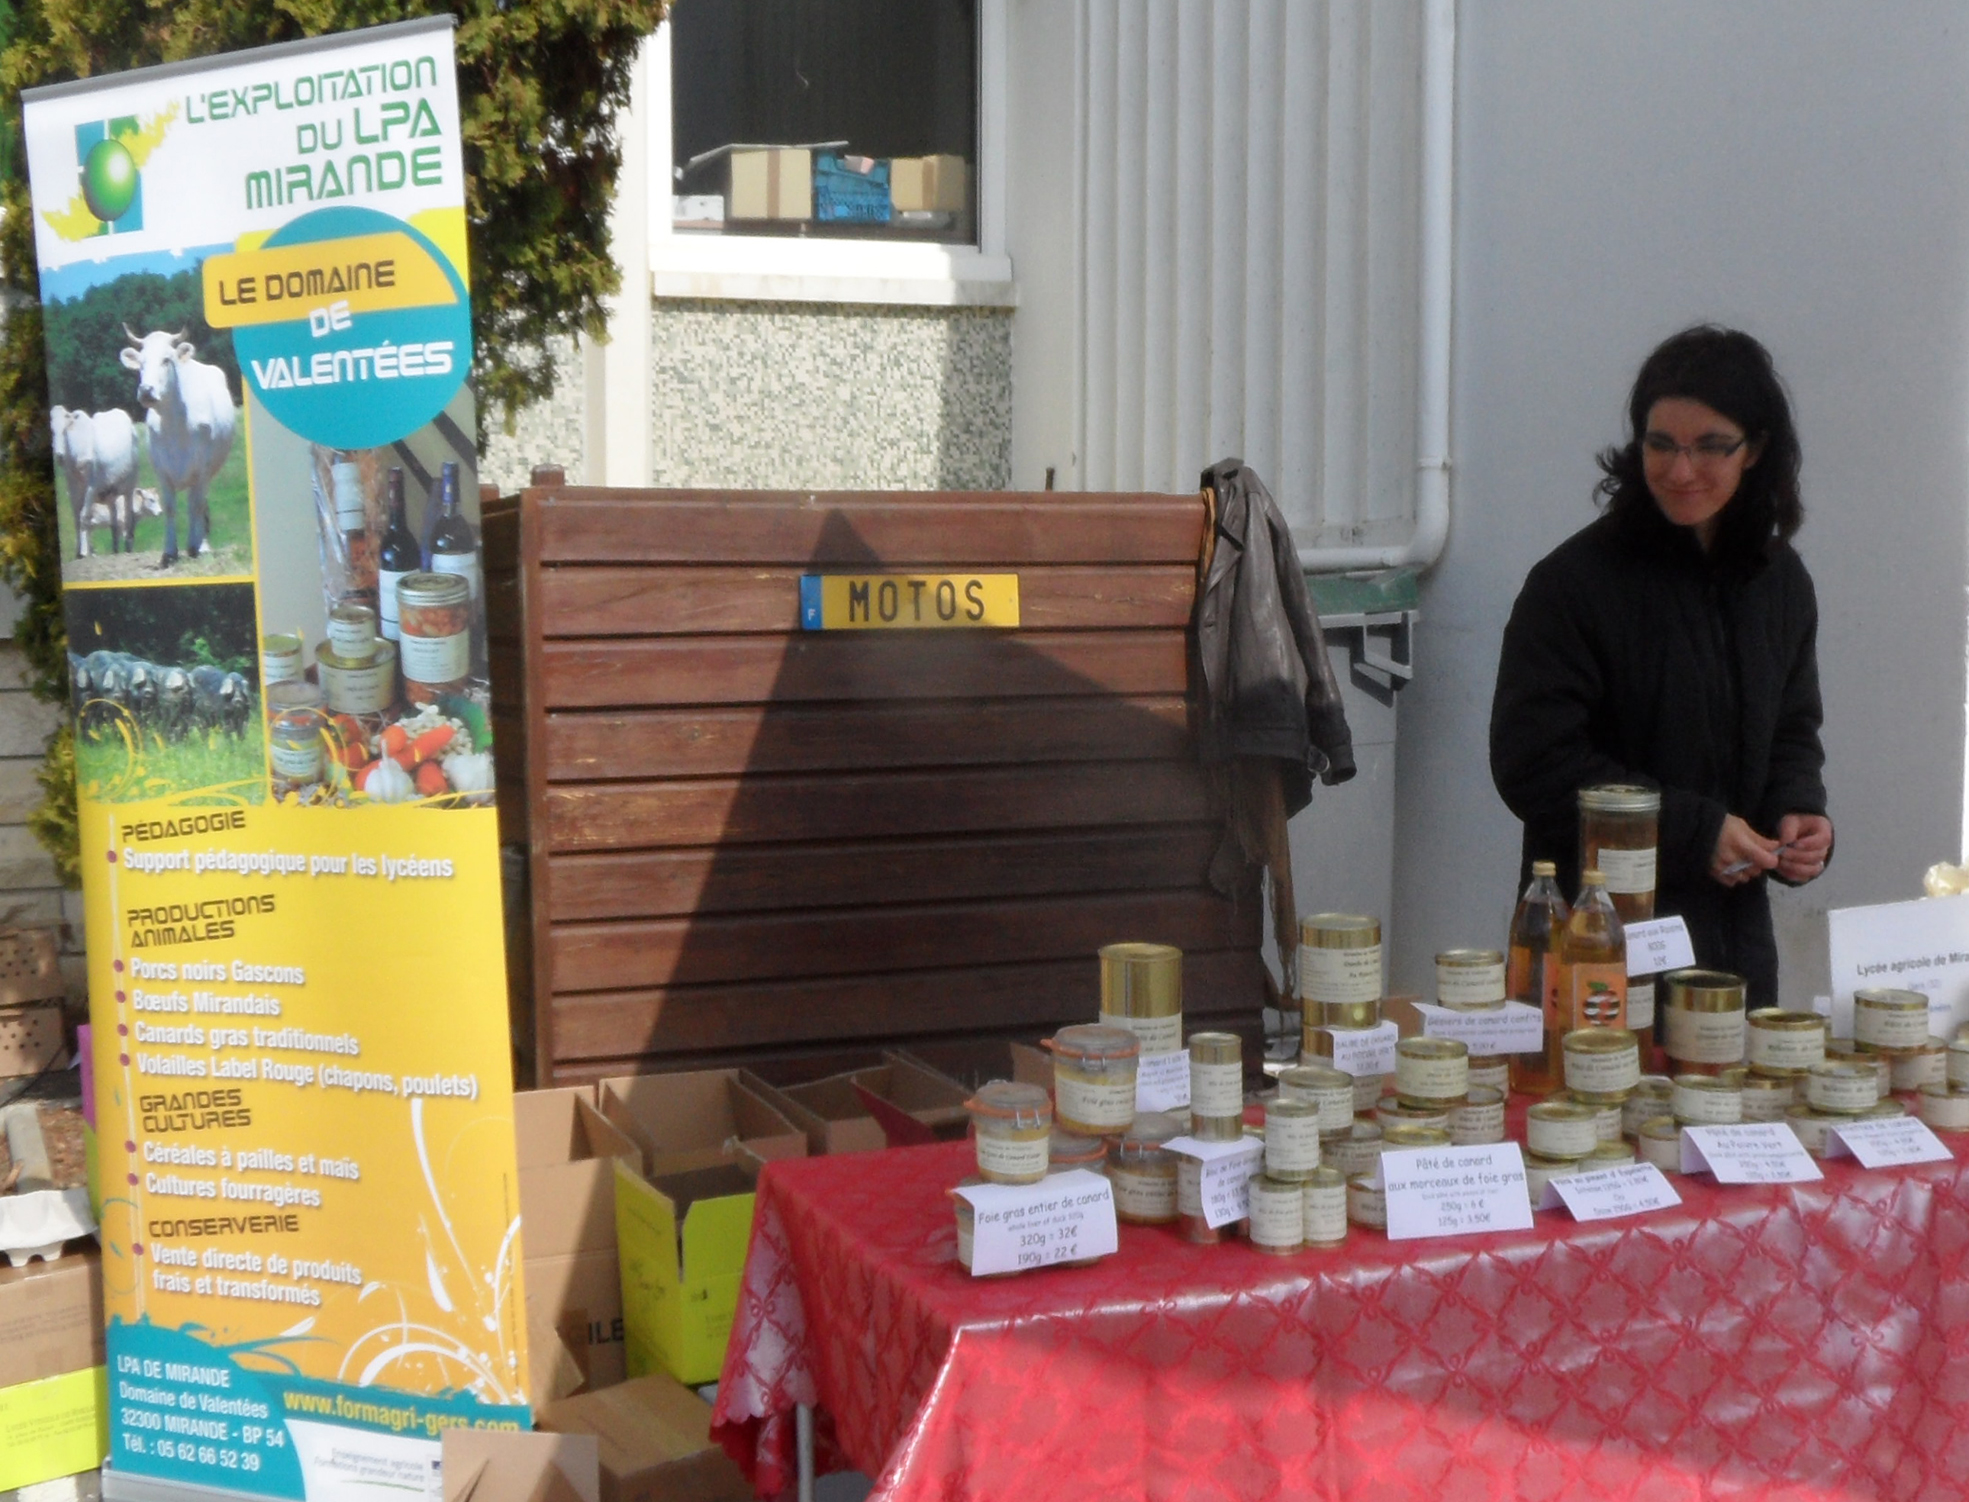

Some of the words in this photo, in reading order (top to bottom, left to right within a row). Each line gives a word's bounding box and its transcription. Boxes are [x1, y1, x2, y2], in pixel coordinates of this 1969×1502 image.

[186, 55, 437, 124] L'EXPLOITATION
[297, 118, 342, 155] DU
[354, 97, 442, 145] LPA
[245, 145, 442, 209] MIRANDE
[218, 277, 257, 306] LE
[265, 260, 395, 301] DOMAINE
[309, 300, 353, 337] DE
[251, 339, 454, 390] VALENTÉES
[849, 579, 984, 622] MOTOS
[121, 810, 246, 843] PÉDAGOGIE
[123, 847, 191, 873] Support
[194, 848, 306, 875] pédagogique
[310, 854, 347, 876] pour
[352, 853, 377, 875] les
[381, 854, 454, 881] lycéens
[126, 893, 275, 928] PRODUCTIONS
[131, 920, 235, 948] ANIMALES
[131, 957, 178, 980] Porcs
[182, 959, 227, 981] noirs
[232, 959, 305, 984] Gascons
[1857, 963, 1887, 978] Lycée
[1891, 956, 1932, 973] agricole
[1934, 954, 1946, 967] de
[133, 989, 189, 1012] Bœufs
[193, 992, 281, 1015] Mirandais
[135, 1021, 204, 1044] Canards
[210, 1027, 248, 1050] gras
[253, 1025, 360, 1055] traditionnels
[138, 1052, 206, 1077] Volailles
[211, 1056, 257, 1079] Label
[261, 1057, 315, 1086] Rouge
[319, 1063, 398, 1096] (chapons,
[402, 1073, 478, 1100] poulets)
[140, 1088, 242, 1113] GRANDES
[143, 1108, 251, 1133] CULTURES
[144, 1141, 216, 1166] Céréales
[221, 1146, 232, 1167] à
[237, 1147, 293, 1172] pailles
[298, 1153, 315, 1173] et
[319, 1157, 359, 1179] maïs
[1415, 1157, 1440, 1170] Pâté
[1442, 1156, 1455, 1169] de
[1457, 1154, 1493, 1167] canard
[146, 1173, 216, 1198] Cultures
[221, 1178, 321, 1207] fourragères
[1388, 1182, 1407, 1192] aux
[1410, 1178, 1459, 1190] morceaux
[1462, 1174, 1475, 1186] de
[1478, 1173, 1500, 1185] foie
[1501, 1172, 1525, 1186] gras
[979, 1212, 1000, 1225] Foie
[1003, 1207, 1025, 1223] gras
[1028, 1201, 1058, 1215] entier
[1061, 1196, 1074, 1208] de
[1076, 1188, 1110, 1205] canard
[149, 1214, 300, 1237] CONSERVERIE
[1020, 1233, 1046, 1247] 320g
[1058, 1225, 1078, 1240] 32€
[150, 1242, 197, 1267] Vente
[202, 1248, 262, 1272] directe
[267, 1254, 288, 1274] de
[293, 1260, 363, 1285] produits
[1017, 1252, 1042, 1265] 190g
[1054, 1246, 1068, 1258] 22
[152, 1269, 191, 1293] frais
[195, 1275, 213, 1294] et
[216, 1276, 322, 1305] transformés
[117, 1354, 141, 1375] LPA
[143, 1359, 162, 1379] DE
[165, 1363, 230, 1388] MIRANDE
[119, 1381, 176, 1407] Domaine
[179, 1391, 196, 1410] de
[199, 1393, 269, 1419] Valentées
[121, 1407, 161, 1430] 32300
[164, 1415, 228, 1440] MIRANDE
[242, 1425, 262, 1444] BP
[265, 1429, 285, 1448] 54
[122, 1433, 147, 1454] Tél.
[157, 1440, 175, 1458] 05
[177, 1443, 196, 1461] 62
[198, 1446, 216, 1465] 66
[219, 1450, 237, 1468] 52
[240, 1453, 260, 1471] 39
